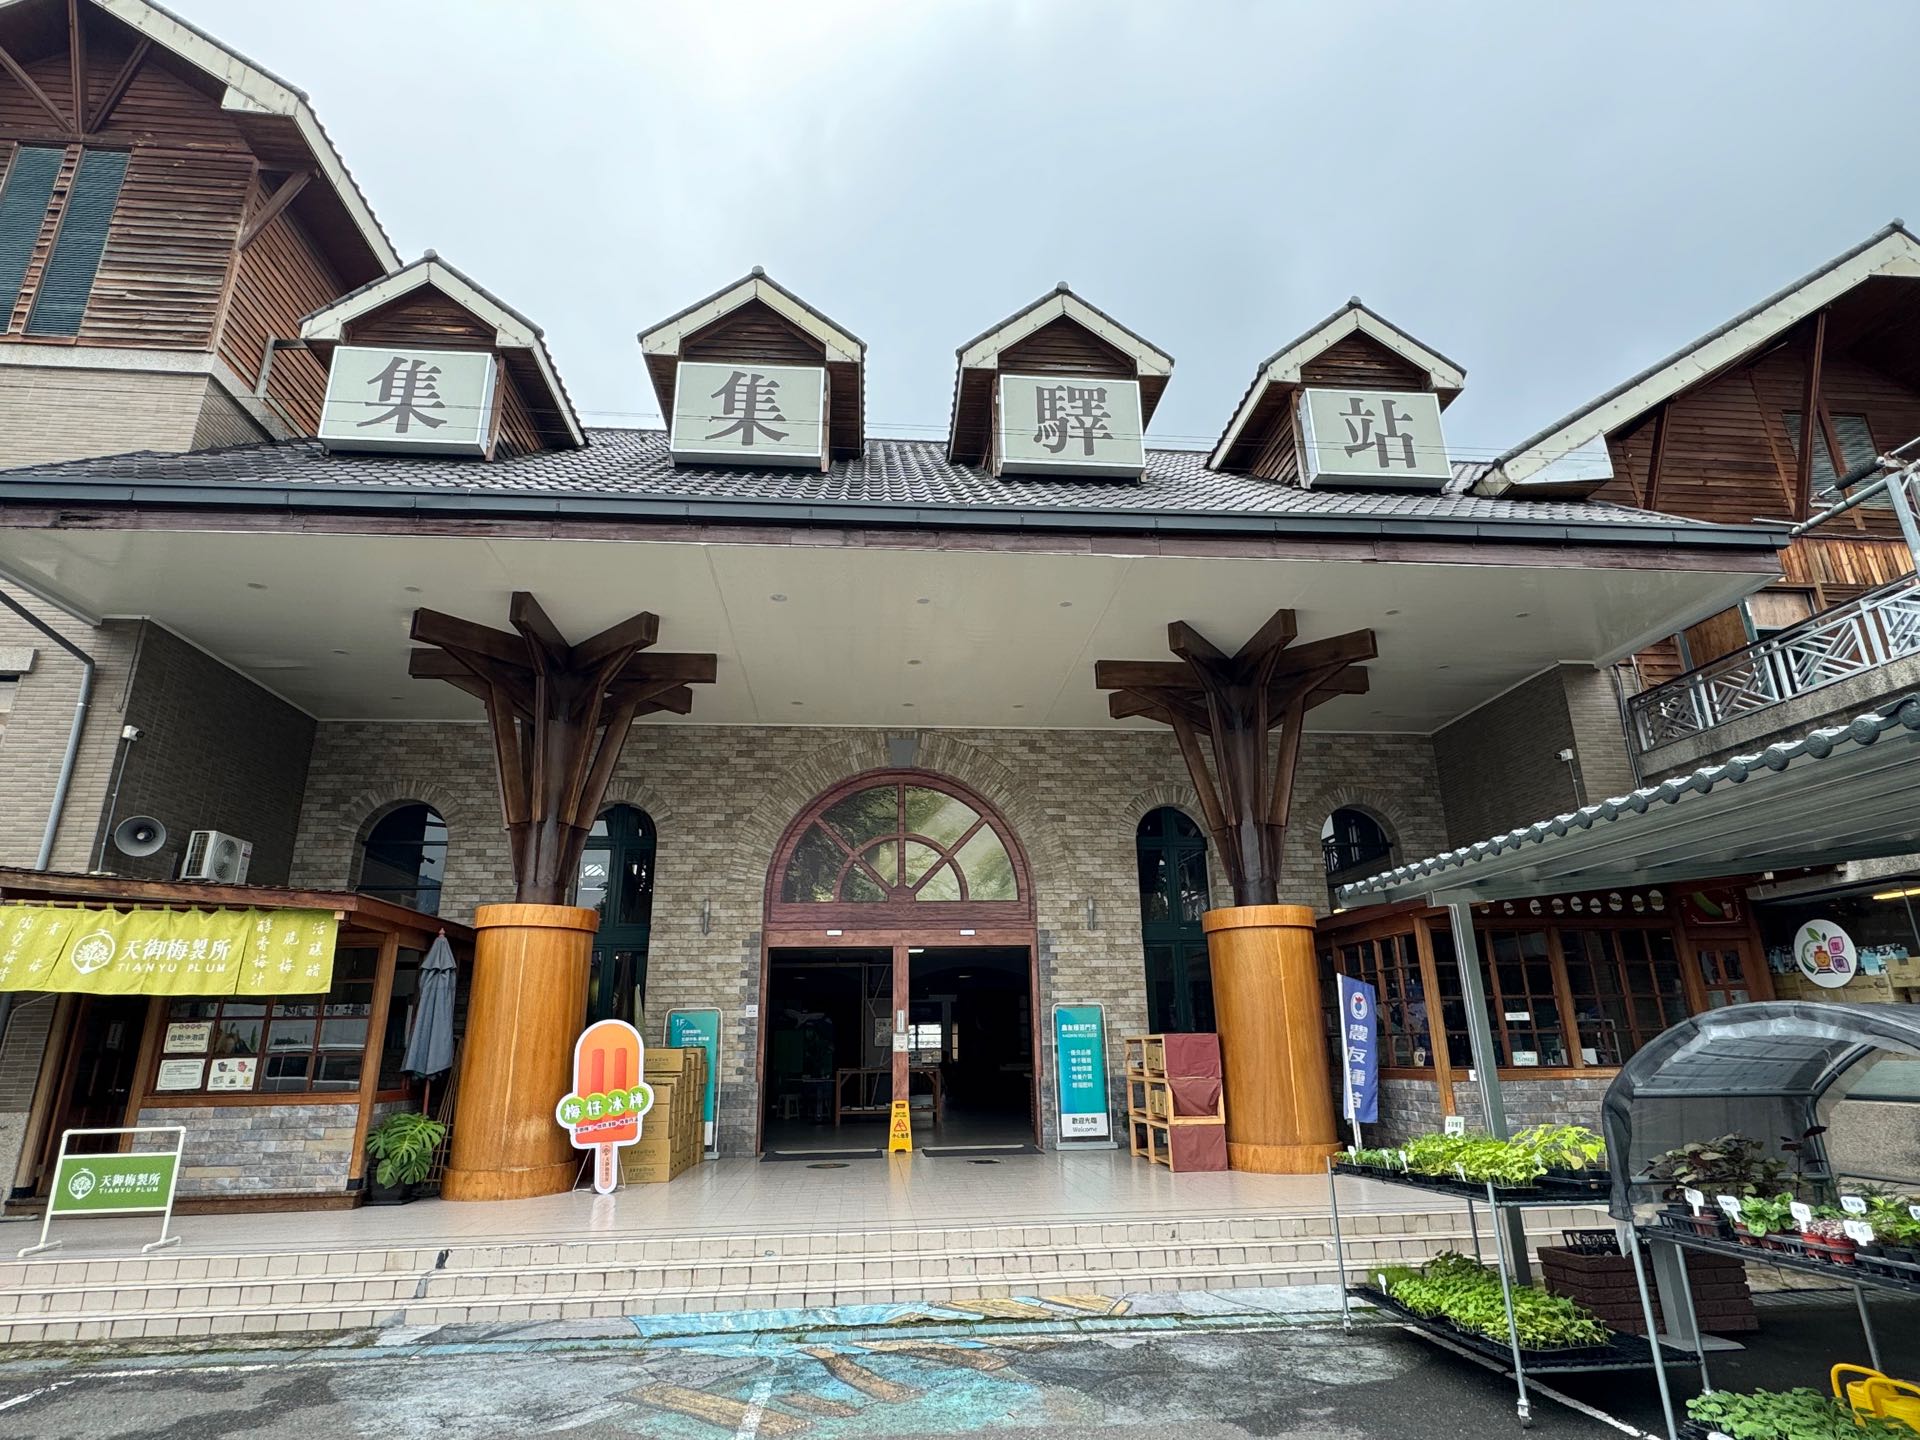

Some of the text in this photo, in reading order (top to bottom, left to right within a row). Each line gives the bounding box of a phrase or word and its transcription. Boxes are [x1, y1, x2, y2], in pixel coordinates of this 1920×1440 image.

[356, 356, 1418, 468] 集 集 驛 站
[119, 938, 232, 961] 天御梅製所
[118, 963, 226, 973] TIANYU PLUM
[564, 1091, 644, 1121] 梅仔冰棒
[99, 1172, 161, 1187] 天御梅製所
